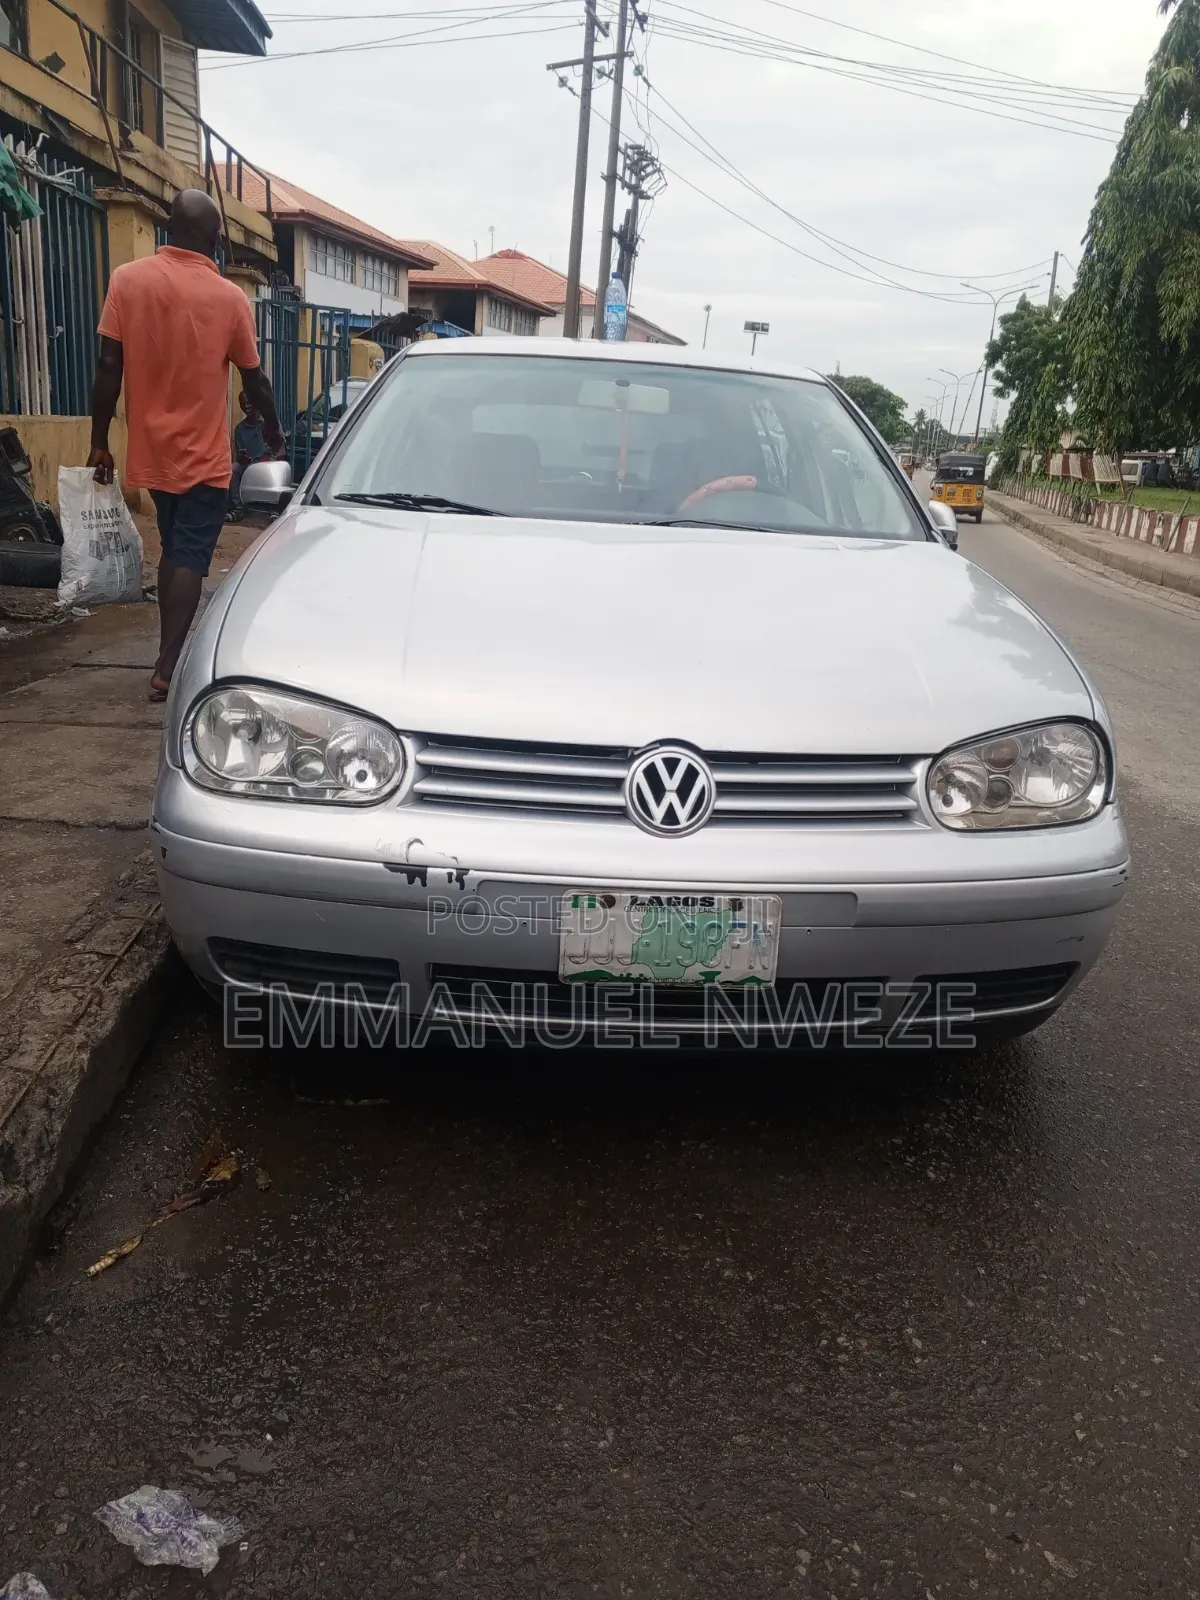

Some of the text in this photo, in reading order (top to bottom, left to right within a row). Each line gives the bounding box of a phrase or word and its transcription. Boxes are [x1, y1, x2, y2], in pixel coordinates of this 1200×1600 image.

[631, 751, 710, 831] VW
[629, 895, 715, 907] LAGOS
[623, 905, 654, 914] CENTRE
